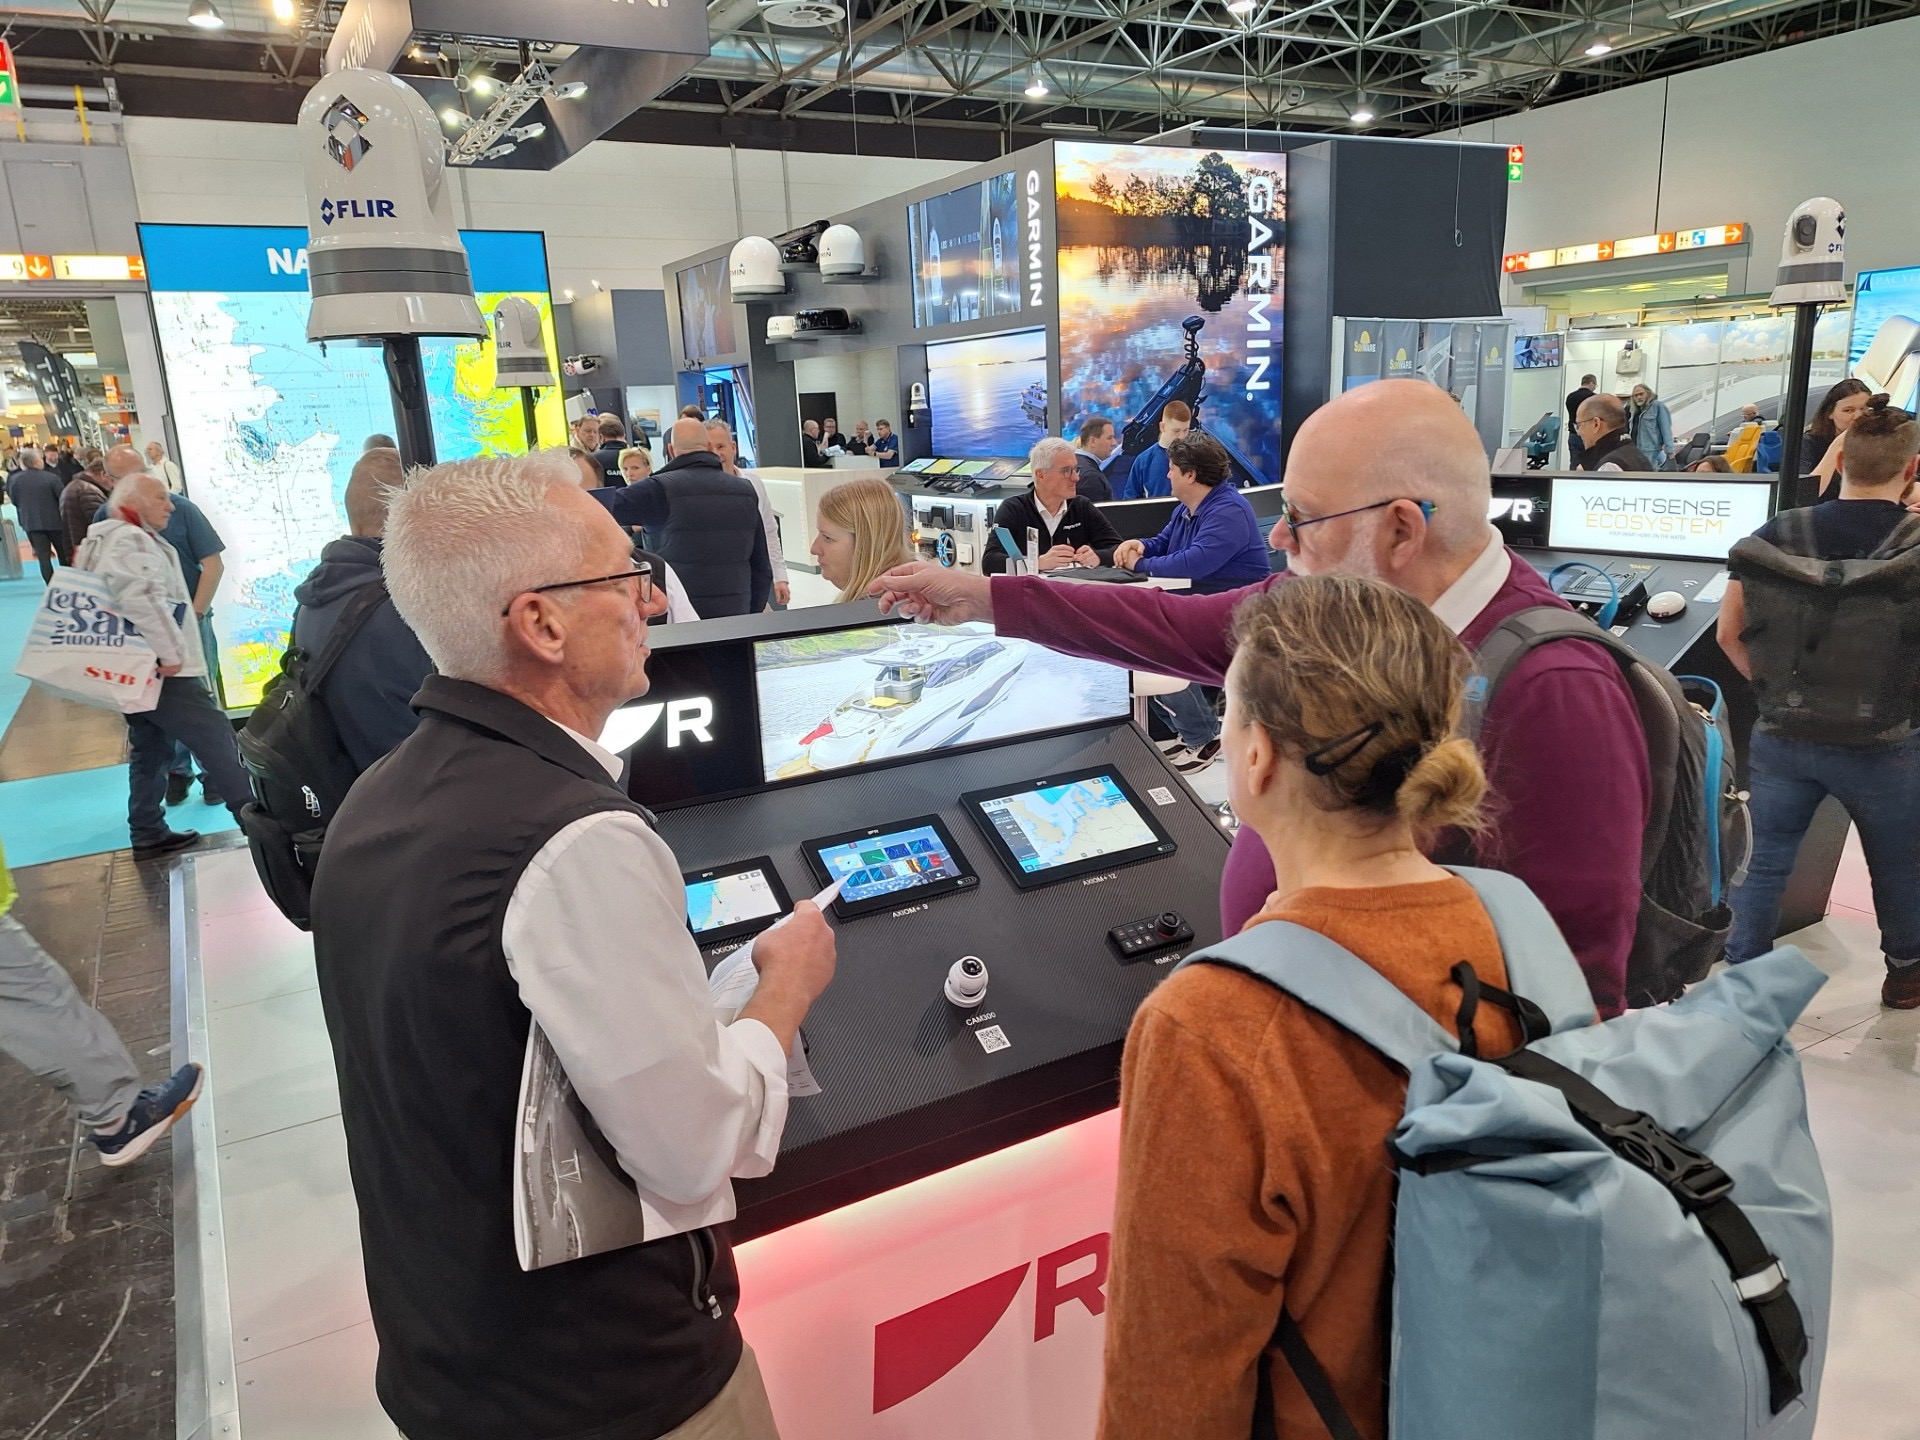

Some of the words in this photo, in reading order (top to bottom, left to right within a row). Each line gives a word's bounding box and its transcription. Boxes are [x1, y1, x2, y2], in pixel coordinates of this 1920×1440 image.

[336, 199, 397, 218] FLIR
[1026, 169, 1043, 307] GARMIN
[1580, 495, 1732, 517] YACHTSENSE
[1586, 513, 1723, 535] ECOSYSTEM
[84, 666, 136, 686] SVB
[965, 1011, 997, 1026] CAM300
